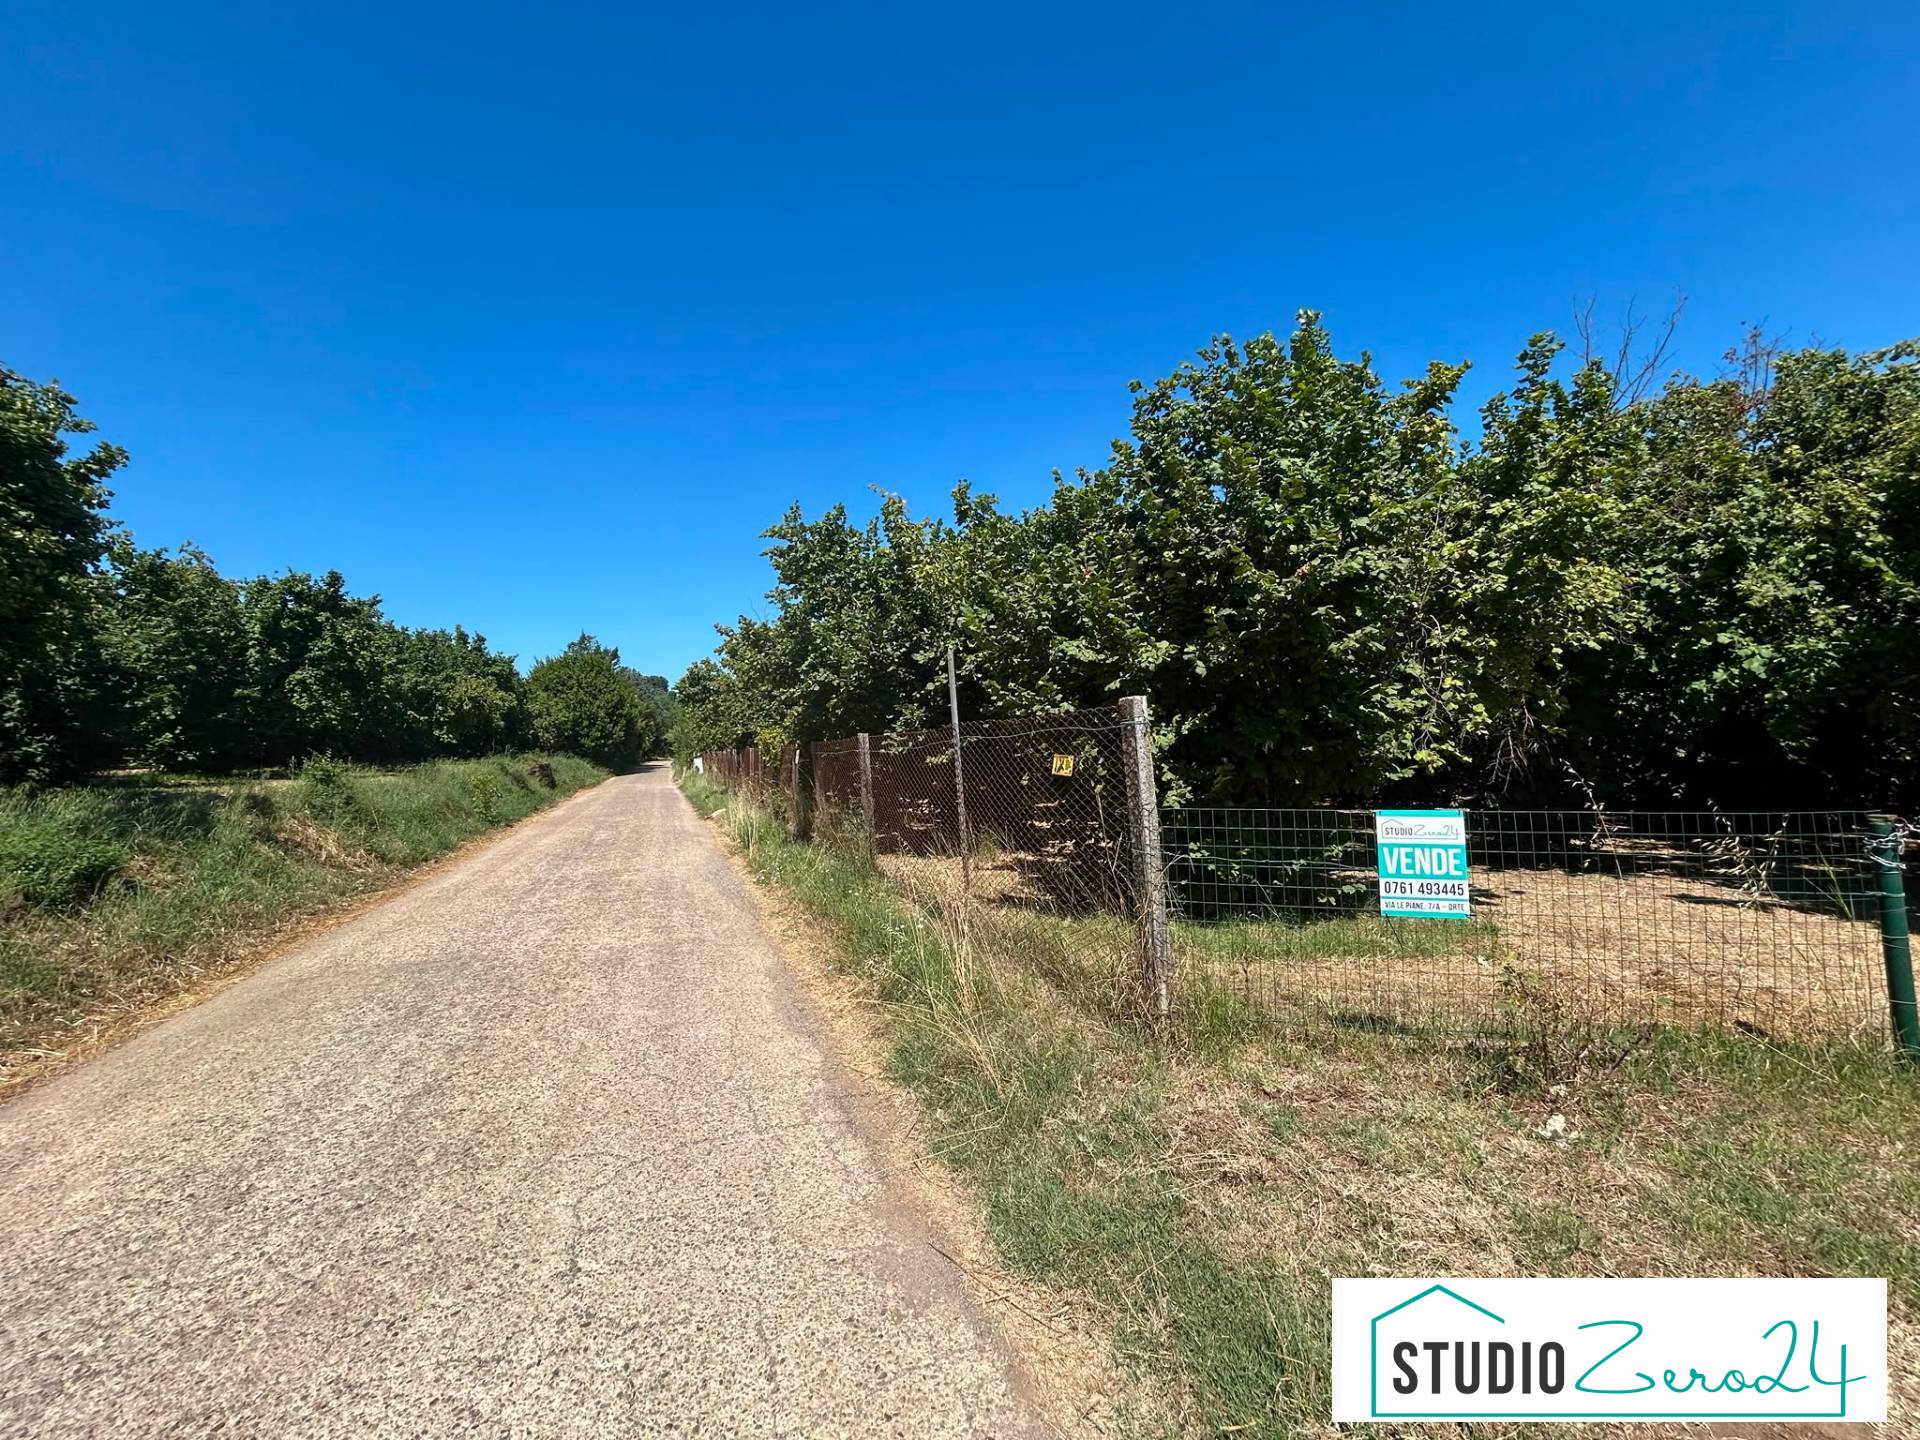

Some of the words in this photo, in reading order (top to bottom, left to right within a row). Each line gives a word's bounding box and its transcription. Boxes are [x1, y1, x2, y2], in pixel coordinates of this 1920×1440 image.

[1385, 827, 1413, 836] STUDIO
[1382, 846, 1464, 876] VENDE
[1384, 881, 1413, 895] 0761
[1418, 882, 1464, 896] 493445
[1384, 901, 1396, 909] VIA
[1397, 901, 1406, 909] LE
[1448, 903, 1465, 911] ORTE
